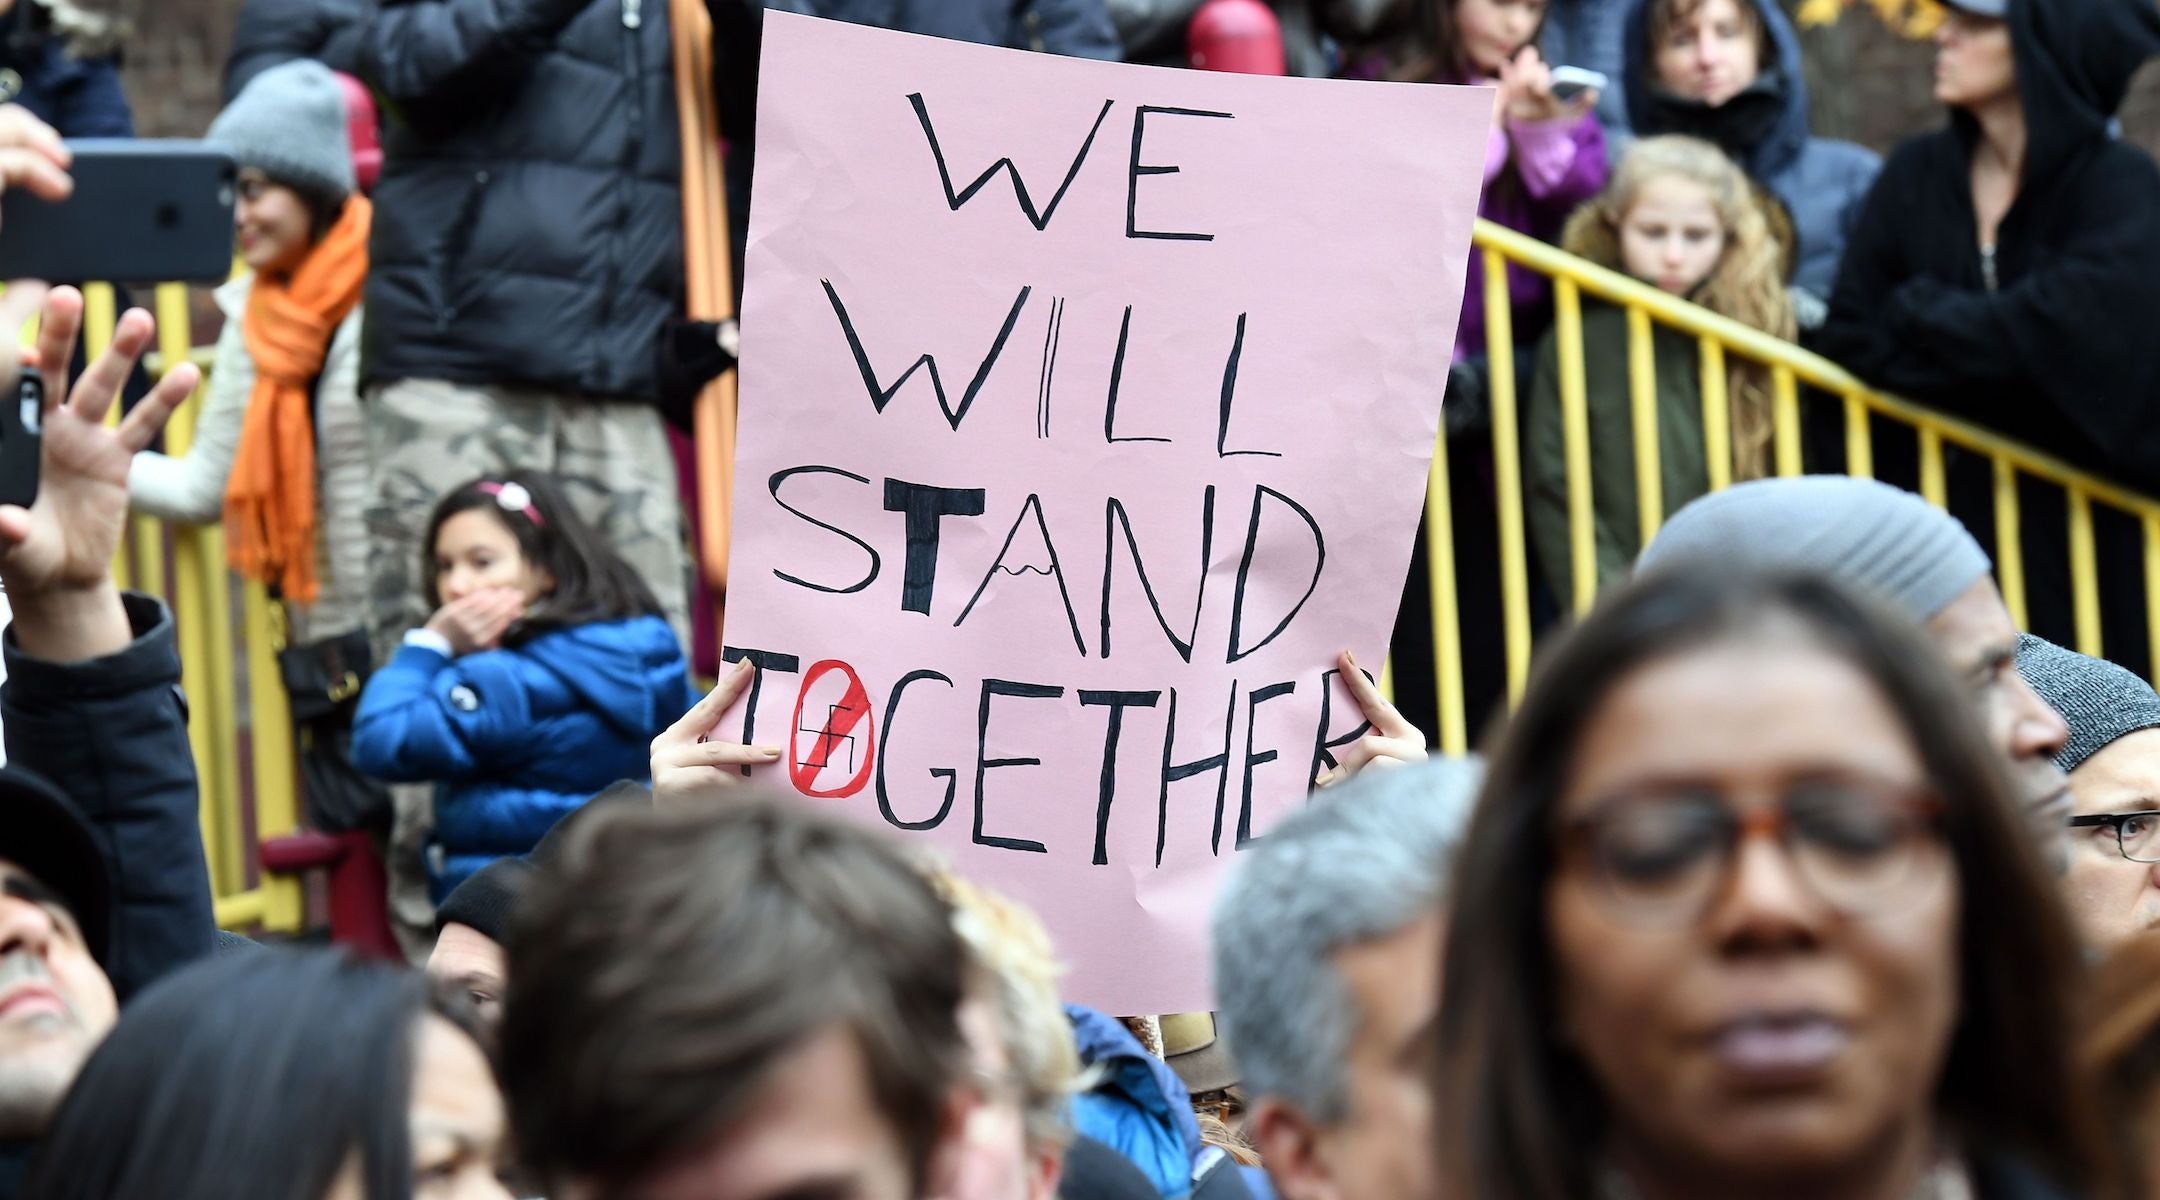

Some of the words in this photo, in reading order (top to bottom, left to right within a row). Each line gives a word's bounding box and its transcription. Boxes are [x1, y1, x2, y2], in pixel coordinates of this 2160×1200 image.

[906, 93, 1235, 241] WE
[821, 278, 1282, 458] WILL
[768, 464, 1325, 664] STAND
